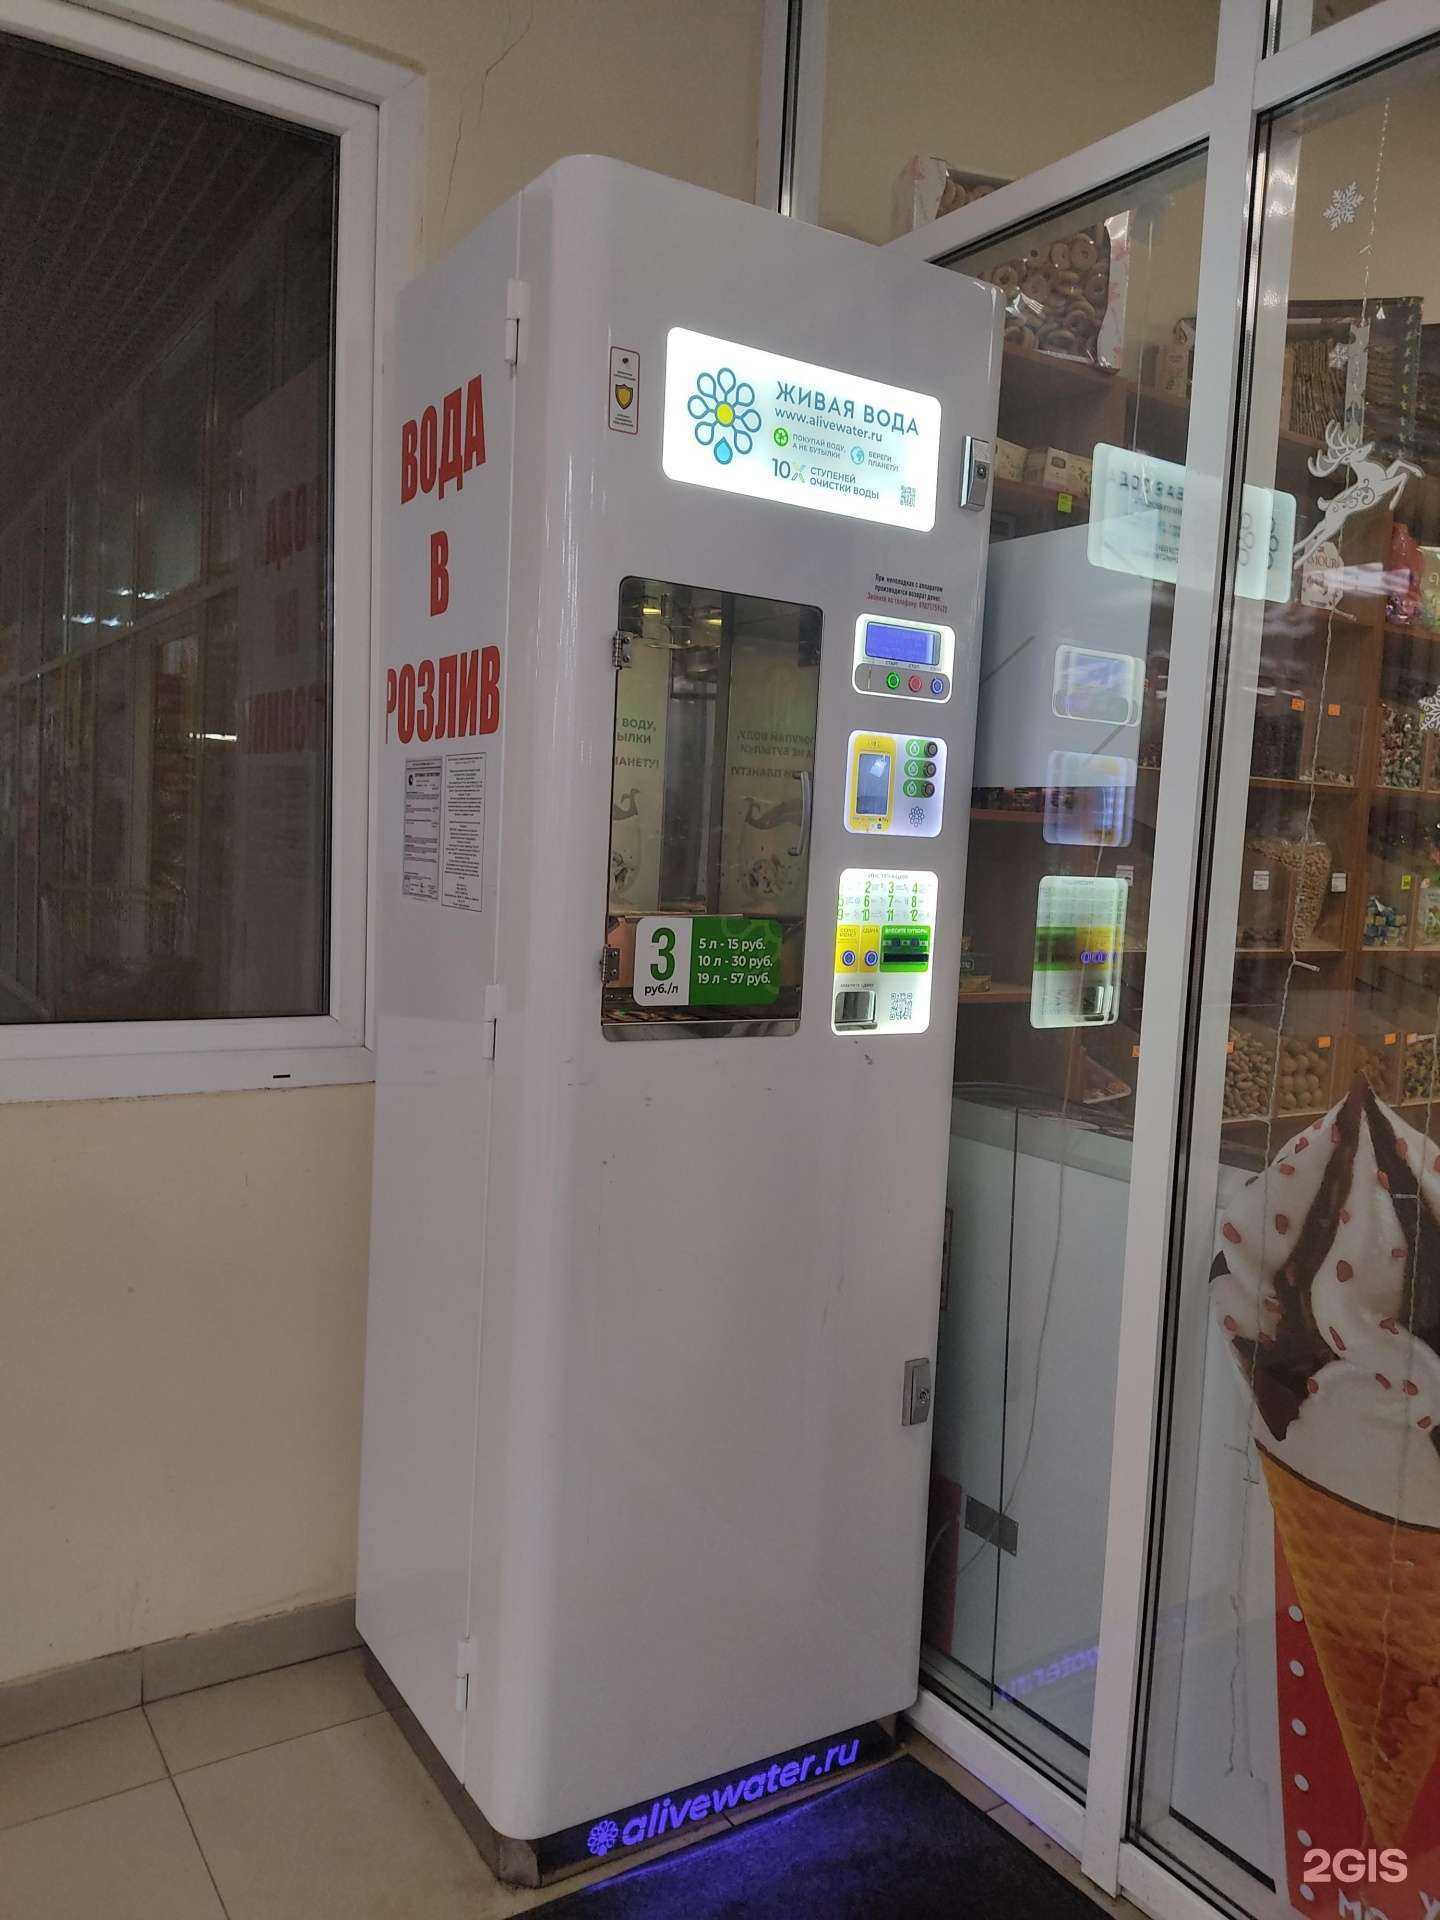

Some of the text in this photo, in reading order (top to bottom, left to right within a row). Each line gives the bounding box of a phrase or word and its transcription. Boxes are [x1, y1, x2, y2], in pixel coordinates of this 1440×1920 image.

[776, 381, 919, 436] ЖИВАЯ ВОДА
[775, 407, 883, 442] www.alivewater.ru
[401, 374, 486, 504] ВОДА
[810, 467, 856, 484] СТУПЕНЕЙ
[810, 477, 880, 500] ОЧИСТКИ ВОДЫ
[430, 530, 450, 617] В
[386, 645, 501, 744] РОЗЛИВ
[622, 717, 657, 732] ВОДУ,
[865, 881, 872, 894] 2
[888, 881, 894, 894] 3
[912, 882, 918, 893] 4
[864, 895, 870, 907] 6
[888, 895, 894, 907] 7
[912, 896, 917, 907] 8
[863, 909, 870, 921] 10
[888, 909, 894, 921] 11
[910, 910, 918, 921] 12
[699, 938, 706, 949] 5
[709, 940, 717, 950] л
[728, 939, 739, 949] 15
[741, 938, 766, 952] руб.
[650, 927, 676, 981] 3
[699, 955, 710, 966] 10
[713, 957, 721, 966] л
[732, 955, 746, 966] 30
[749, 955, 773, 969] руб.
[697, 973, 710, 984] 19
[712, 974, 720, 984] л
[731, 973, 744, 984] 57
[747, 972, 771, 986] руб.
[644, 982, 679, 996] руб./л
[622, 1739, 860, 1846] alivewater.ru
